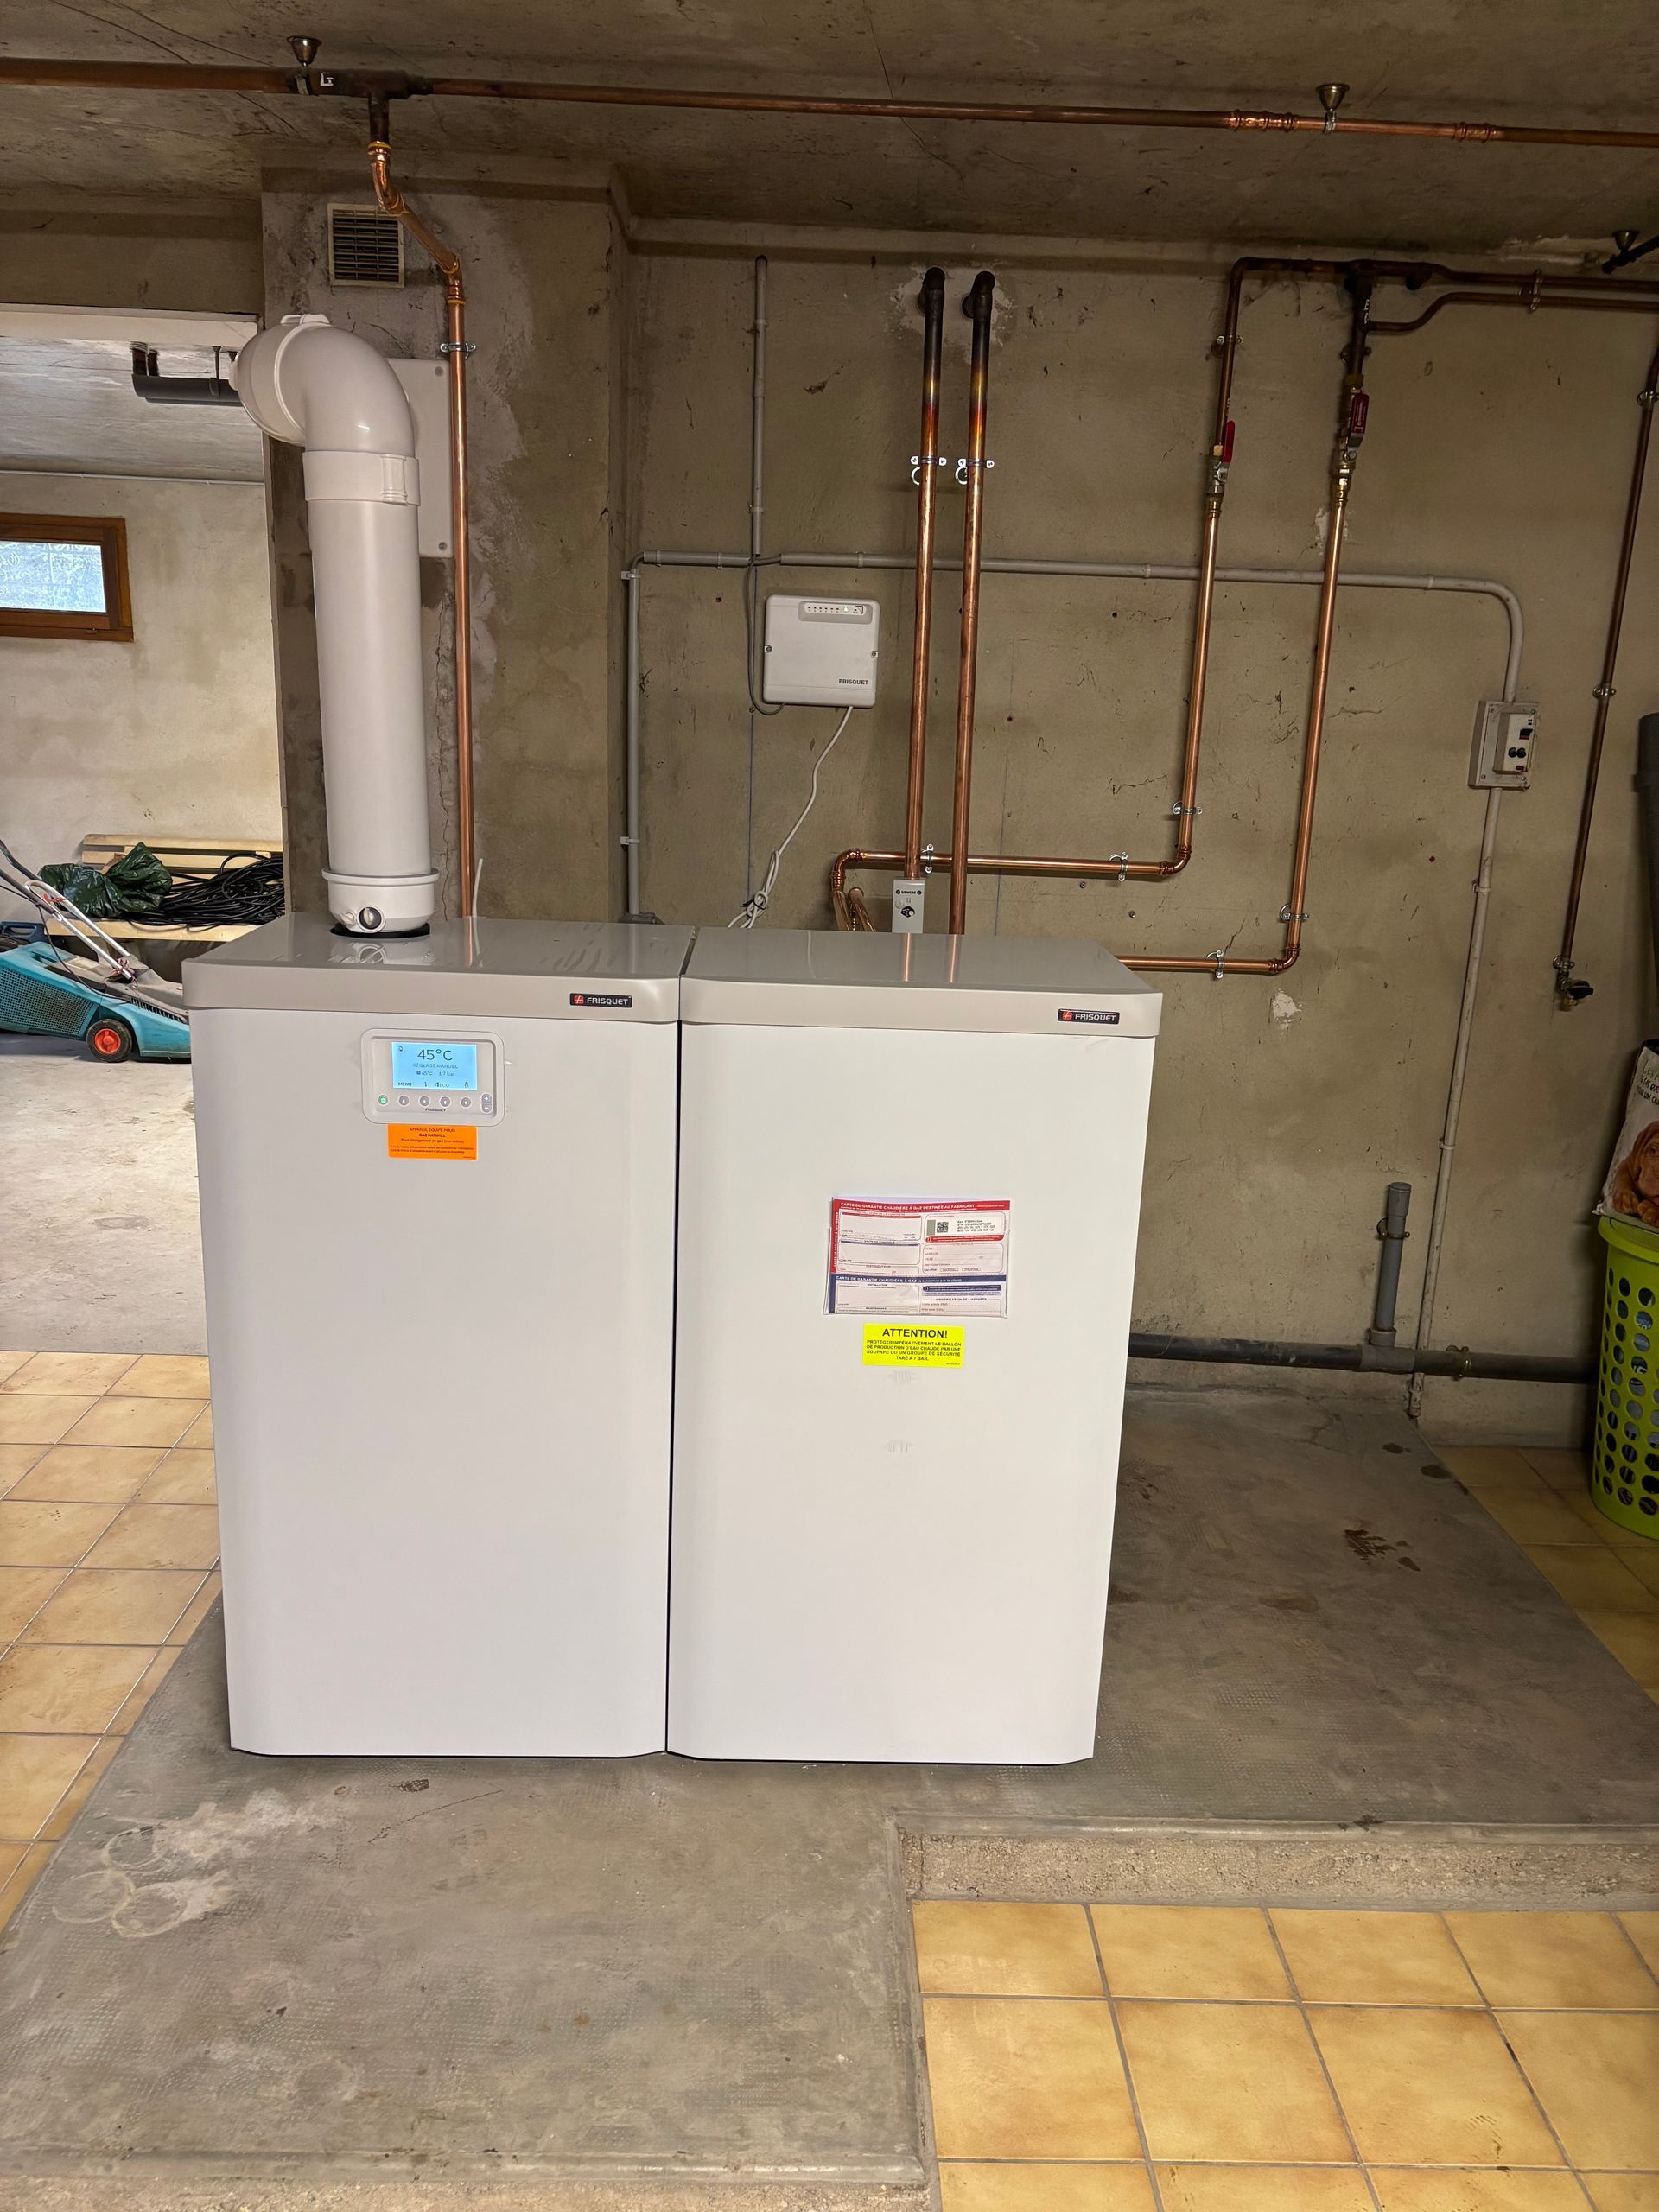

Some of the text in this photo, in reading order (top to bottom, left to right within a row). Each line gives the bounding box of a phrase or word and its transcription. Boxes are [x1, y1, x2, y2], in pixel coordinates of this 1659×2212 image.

[587, 997, 628, 1005] FRISQUET
[1074, 1013, 1116, 1021] FRISQUET
[417, 1049, 453, 1061] 45°C
[882, 1328, 948, 1338] ATTENTION!
